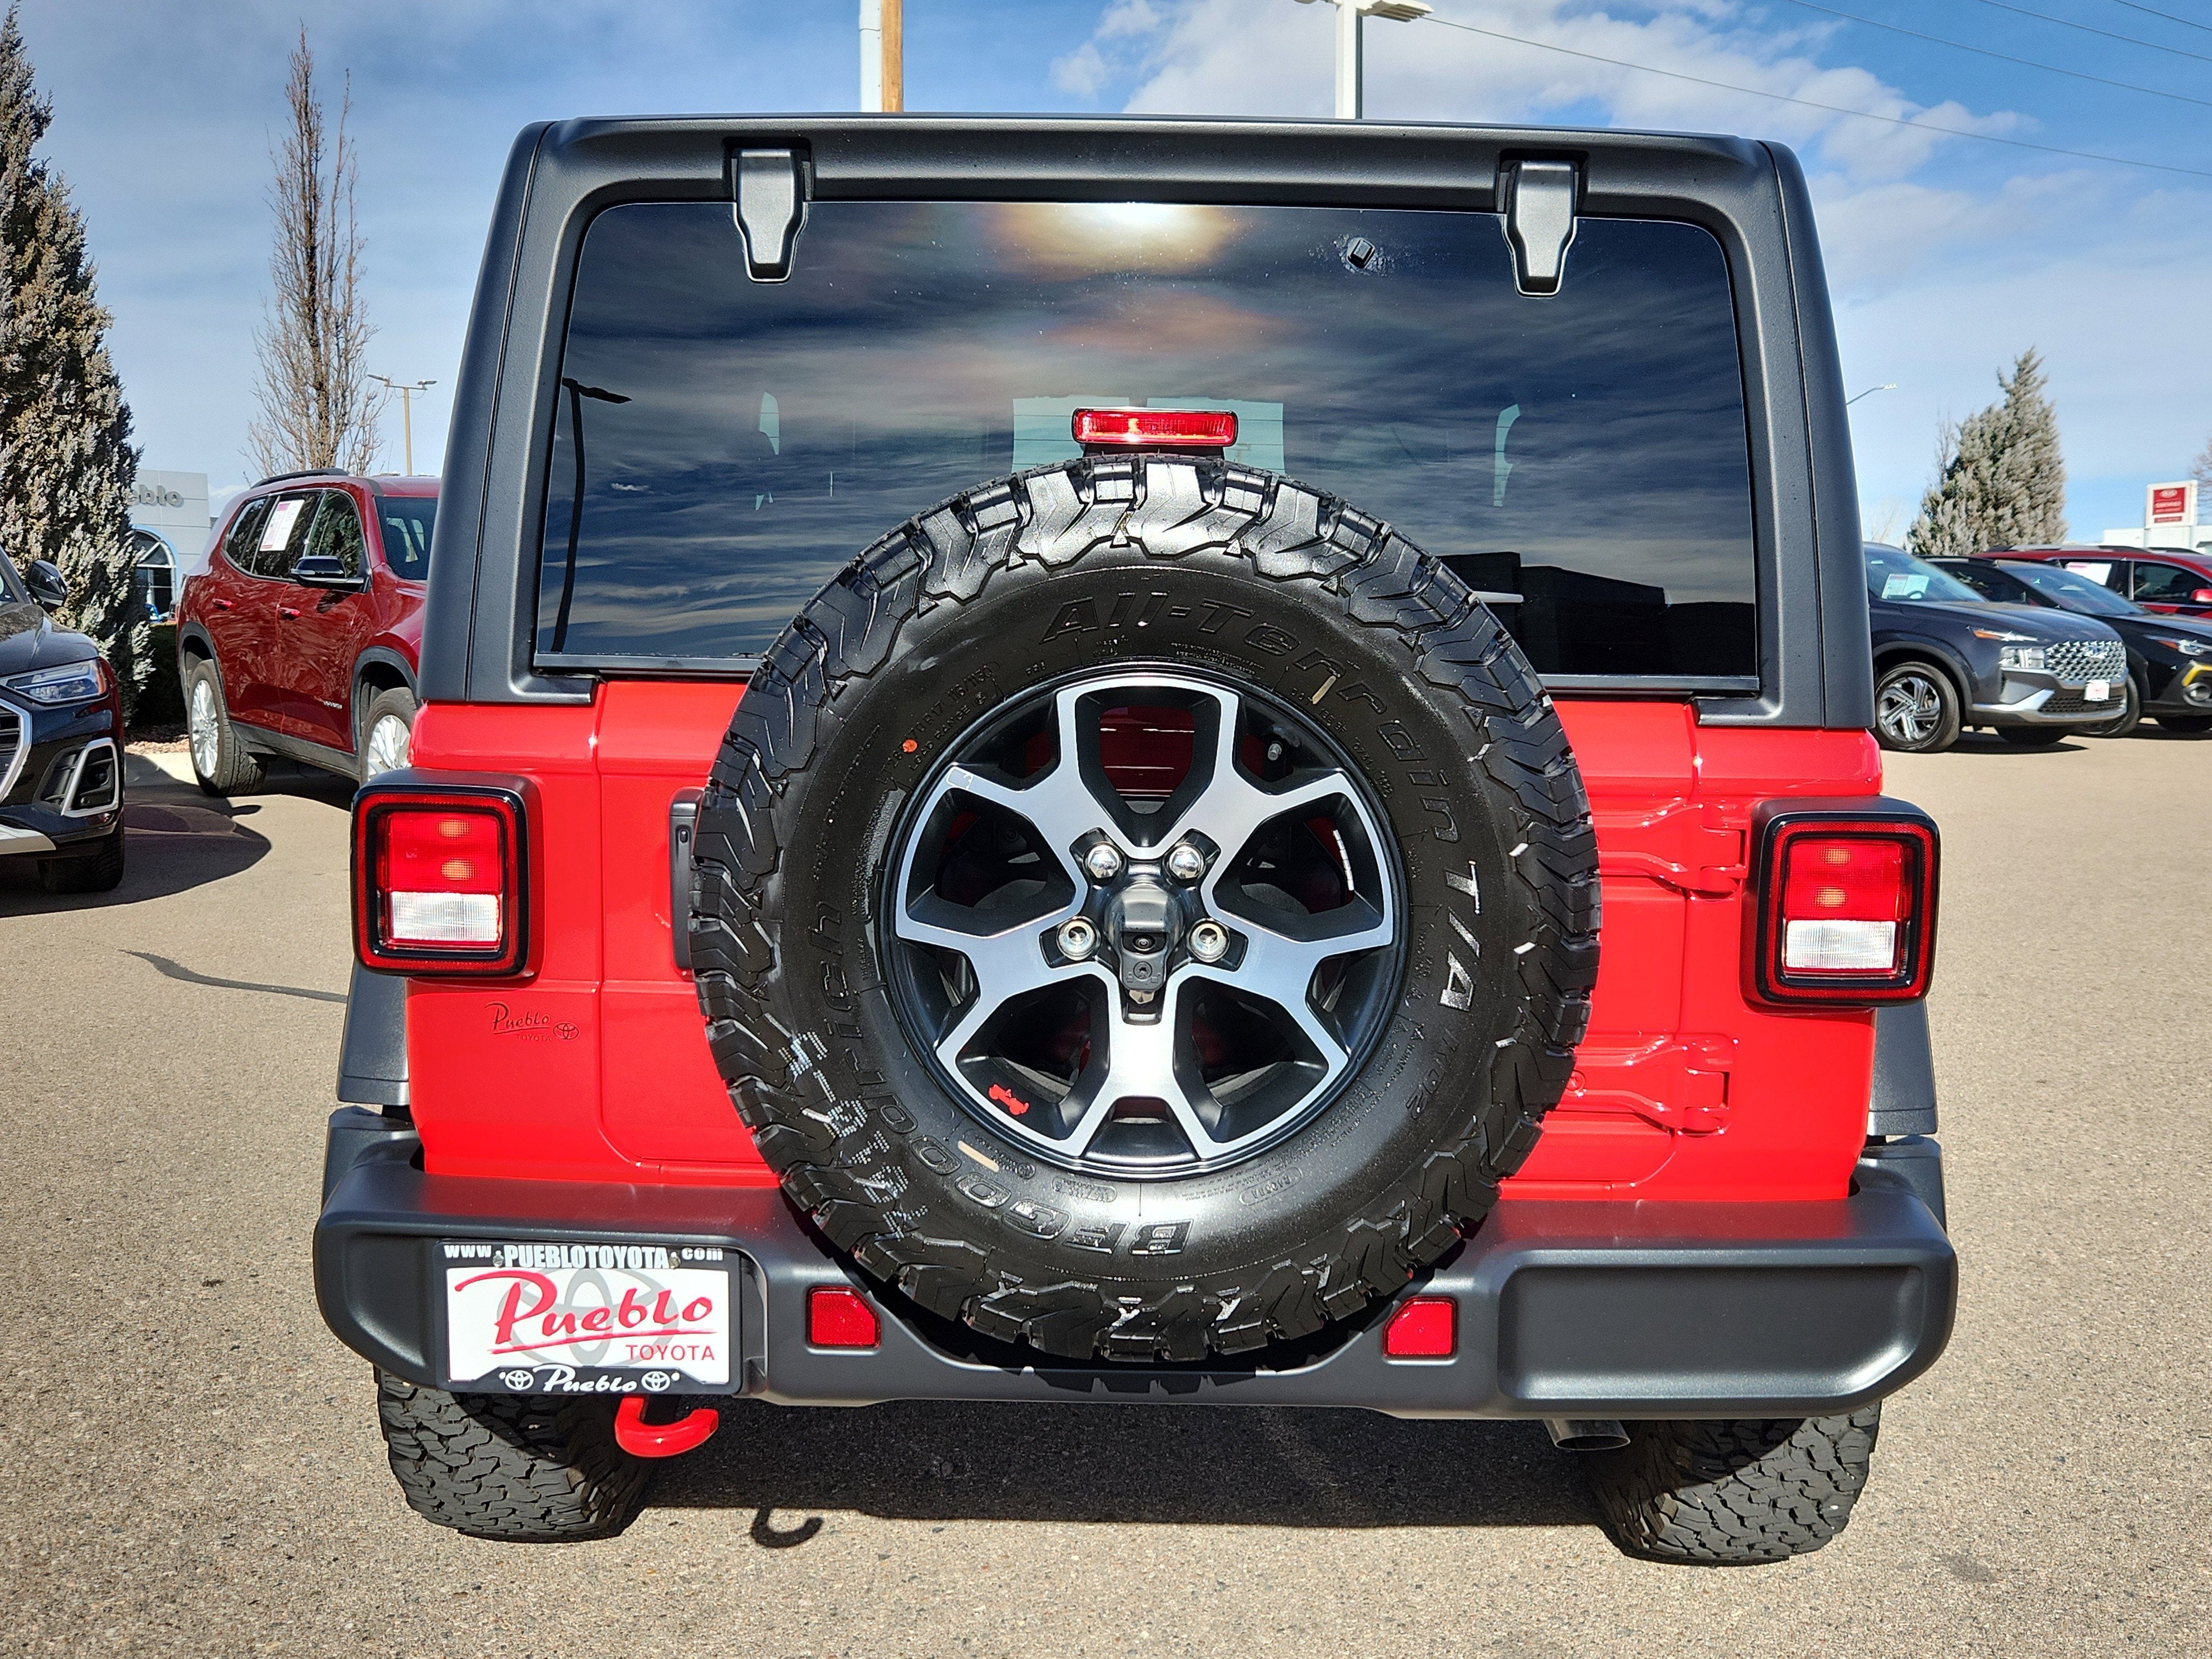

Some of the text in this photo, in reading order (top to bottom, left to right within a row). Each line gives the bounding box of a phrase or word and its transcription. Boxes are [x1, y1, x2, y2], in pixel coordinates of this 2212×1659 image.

[1437, 859, 1482, 1013] T/A
[808, 900, 1195, 1255] BFGoodrich
[454, 1270, 713, 1345] Pueblo
[533, 1364, 637, 1392] Pueblo
[626, 1345, 715, 1361] TOYOTA
